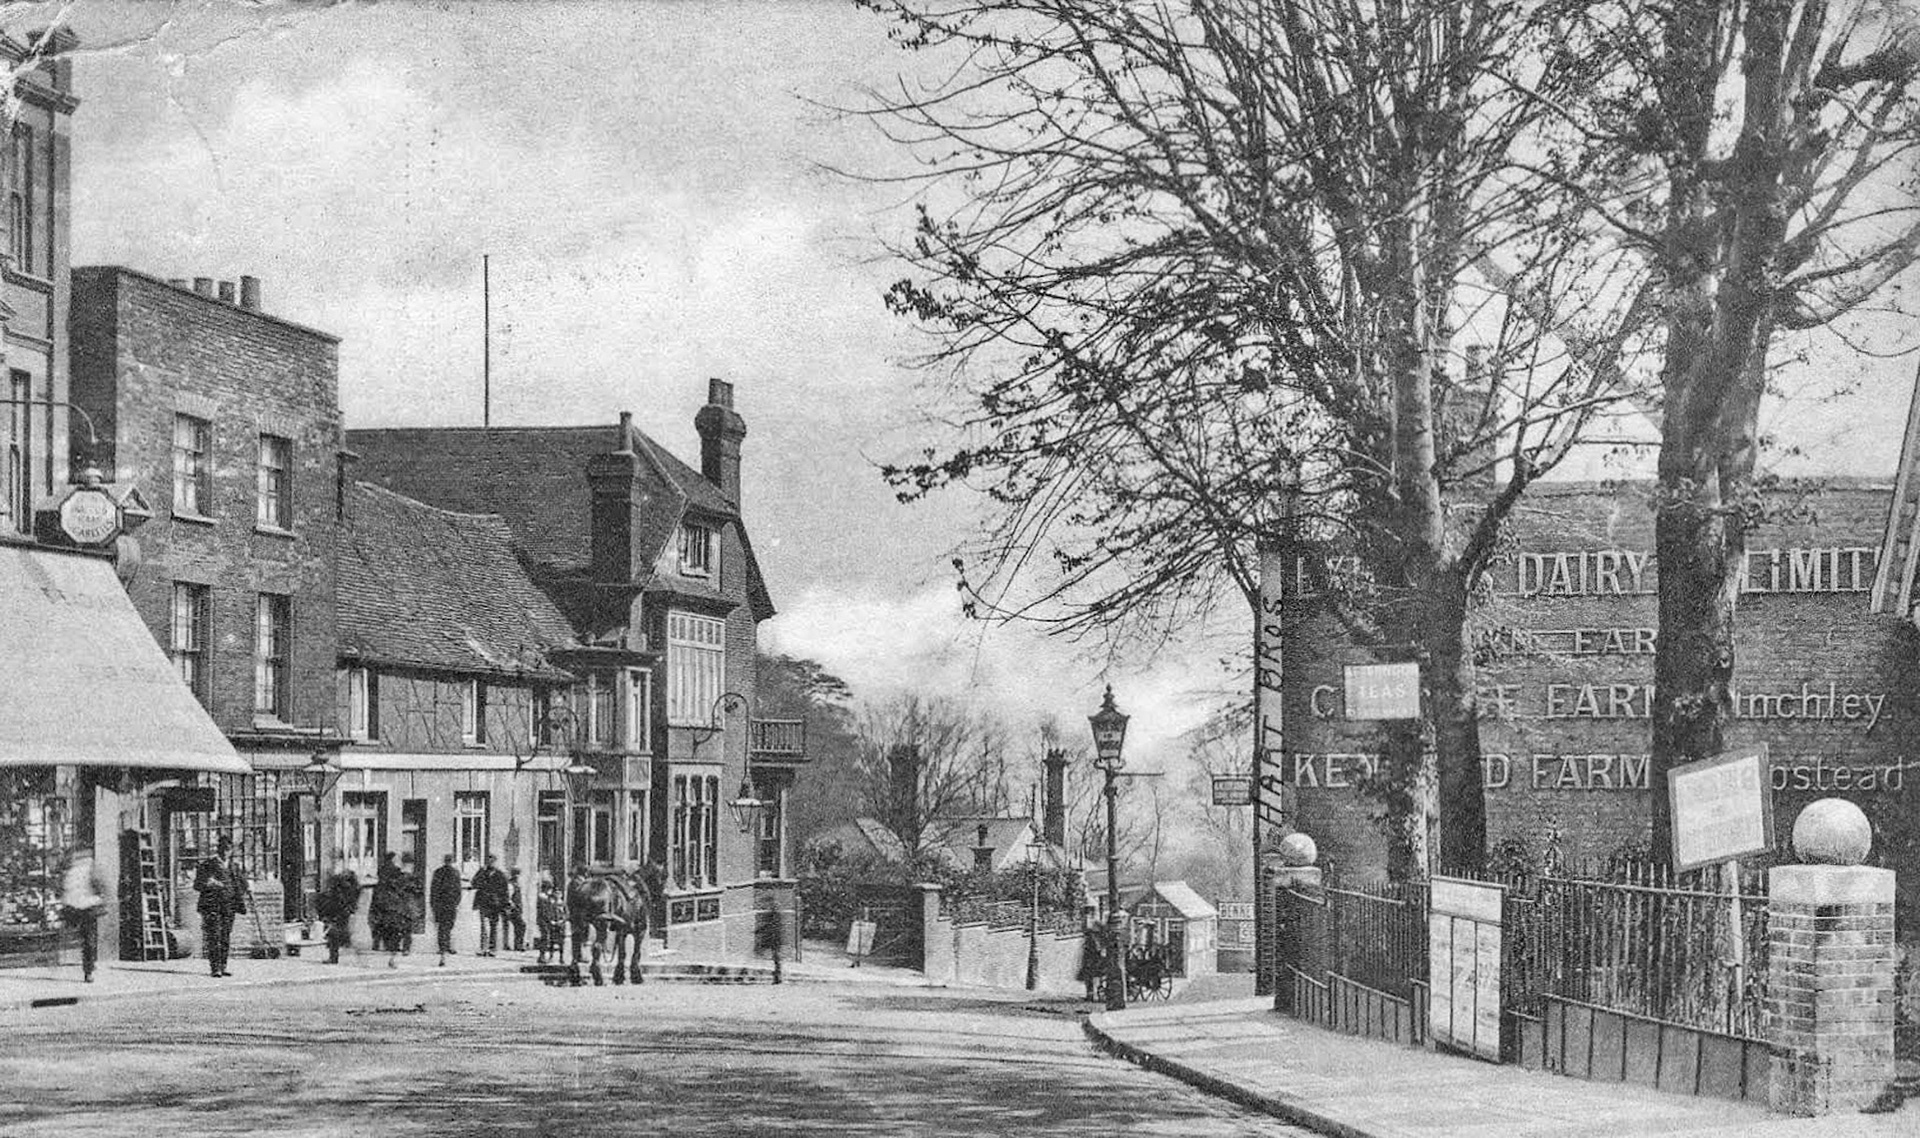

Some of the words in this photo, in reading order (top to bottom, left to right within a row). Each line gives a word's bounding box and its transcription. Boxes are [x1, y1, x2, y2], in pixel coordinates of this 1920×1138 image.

[1519, 550, 1648, 596] DAIRY
[1257, 596, 1285, 692] BROS
[1574, 628, 1658, 654] FAR
[1257, 714, 1285, 827] HART
[1532, 753, 1650, 789] FARM
